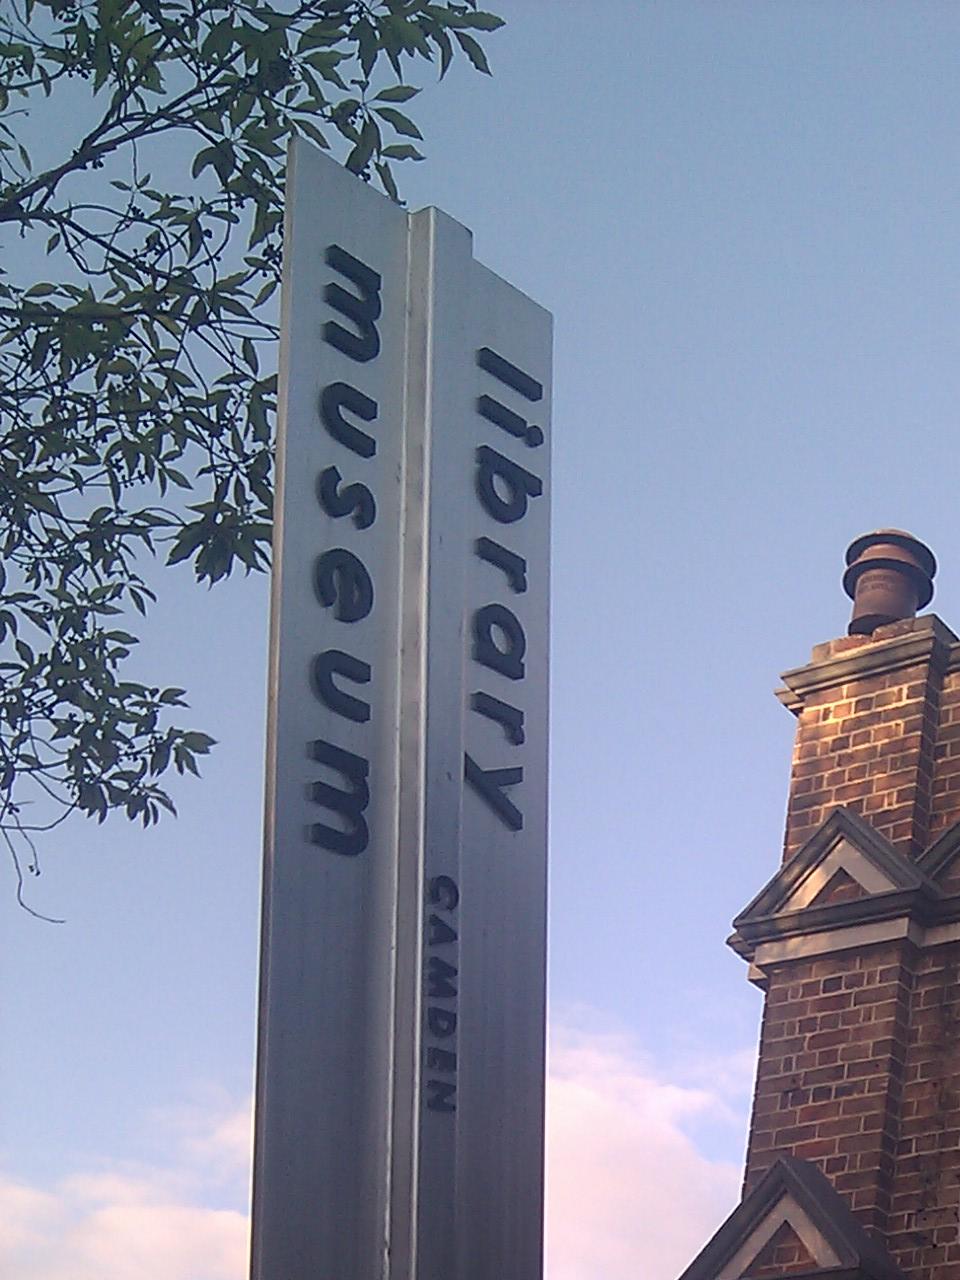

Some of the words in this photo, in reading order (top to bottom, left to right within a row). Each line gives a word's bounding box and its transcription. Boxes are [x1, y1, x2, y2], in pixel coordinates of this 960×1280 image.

[309, 244, 382, 856] museum
[464, 347, 544, 832] library
[427, 874, 460, 1114] CAMDEN
